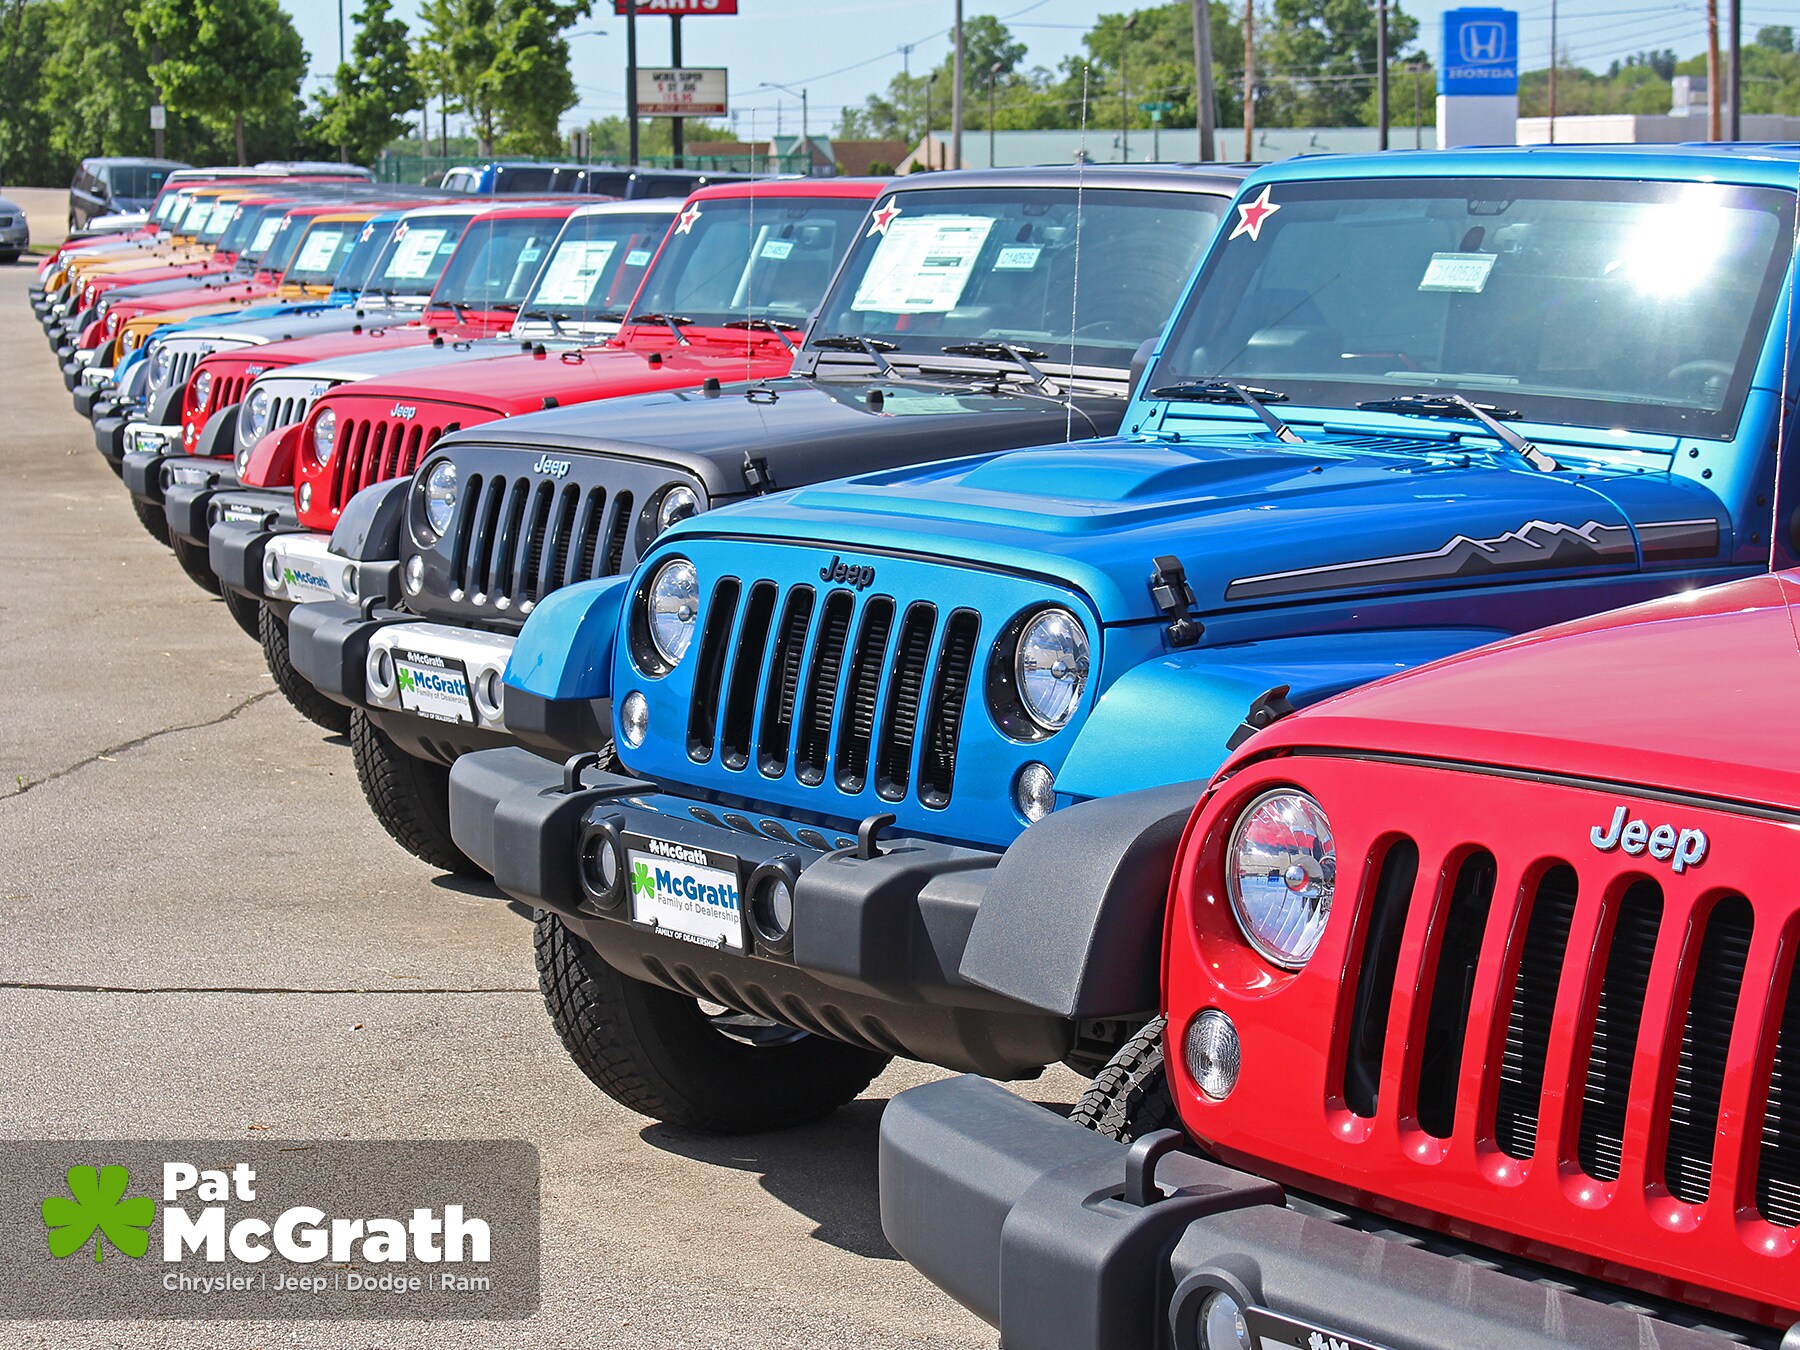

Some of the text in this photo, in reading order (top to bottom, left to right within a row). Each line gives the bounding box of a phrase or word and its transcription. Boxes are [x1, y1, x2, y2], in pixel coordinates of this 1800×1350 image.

[1448, 68, 1515, 79] HONDA
[390, 402, 416, 421] Jeep
[533, 454, 571, 480] Jeep
[293, 569, 331, 590] McGrath
[820, 555, 875, 592] Jeep
[413, 652, 445, 668] McGrath
[413, 670, 469, 698] McGrath
[1590, 806, 1708, 872] Jeep
[658, 841, 708, 866] McGrath
[655, 867, 740, 911] McGrath
[657, 893, 684, 911] Family
[684, 901, 693, 912] of
[655, 926, 720, 950] FAMILY OF DEALERSHIPS
